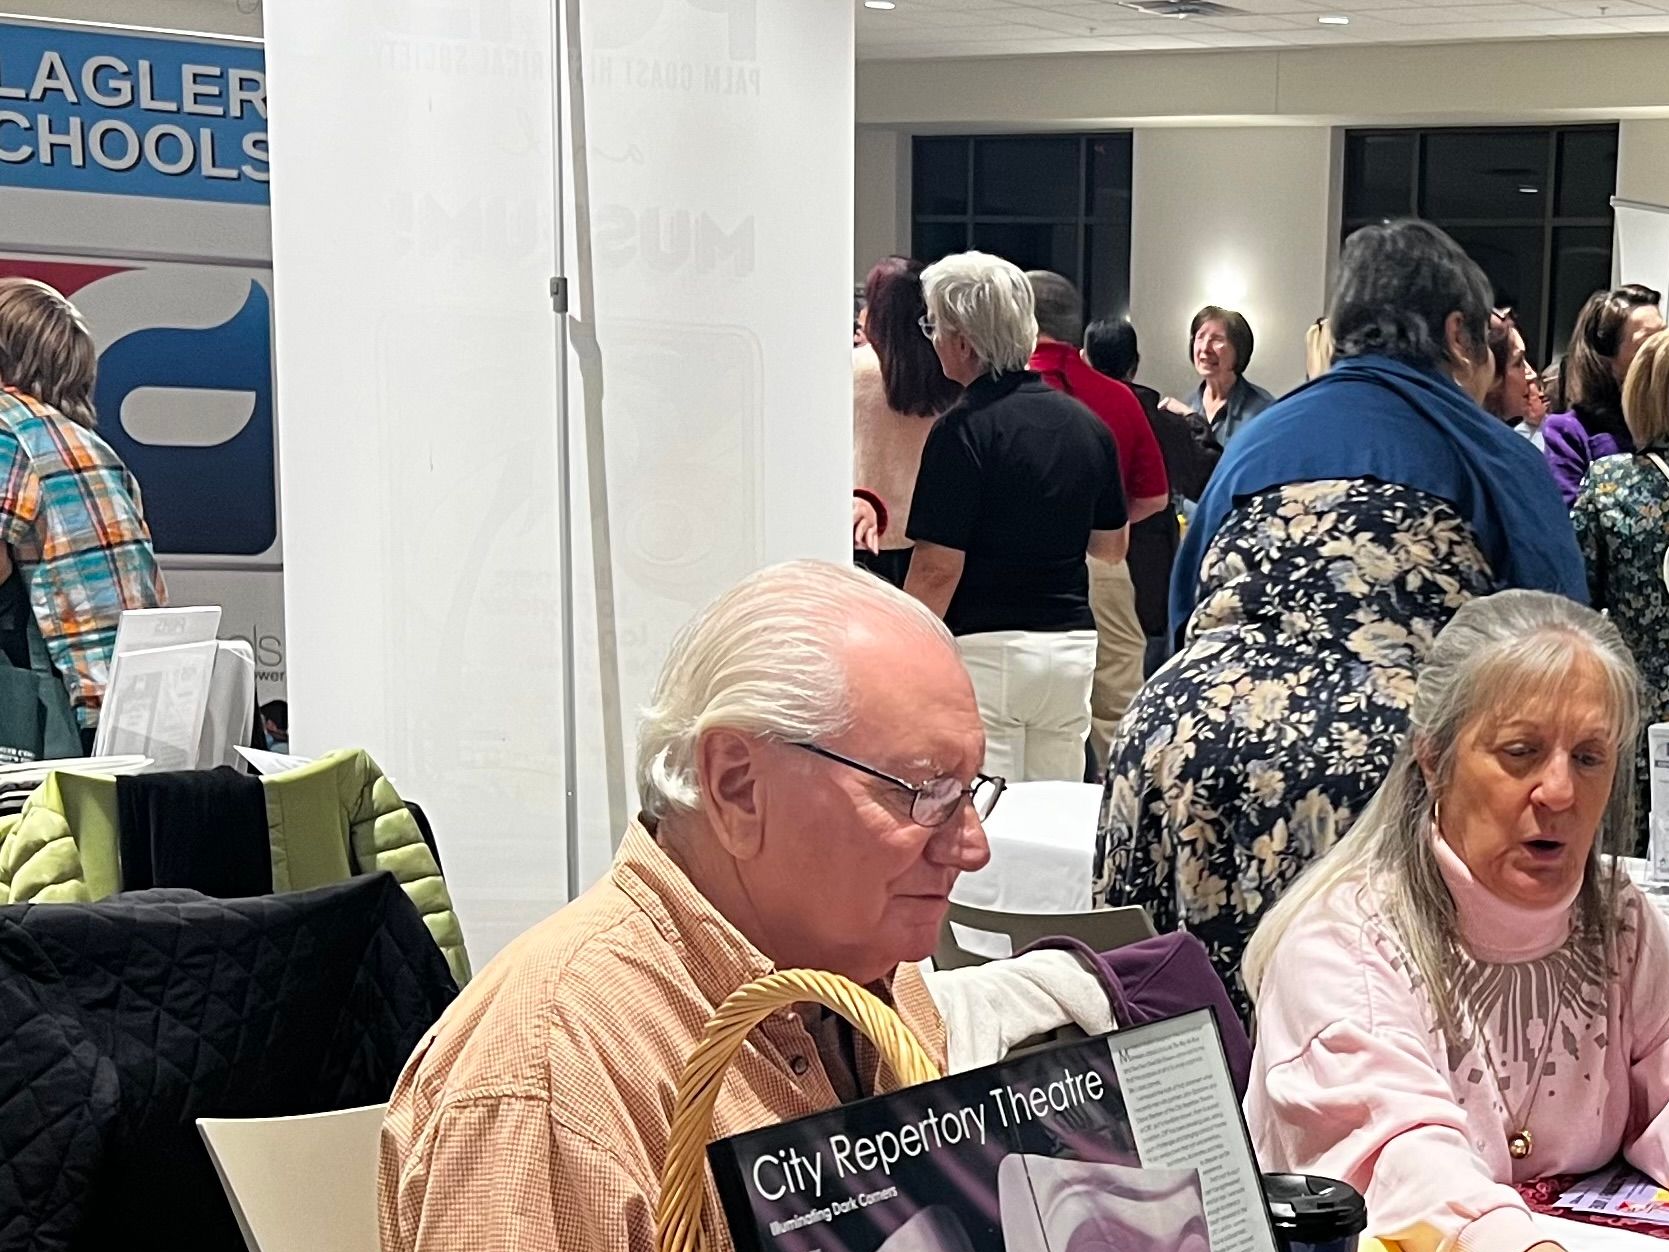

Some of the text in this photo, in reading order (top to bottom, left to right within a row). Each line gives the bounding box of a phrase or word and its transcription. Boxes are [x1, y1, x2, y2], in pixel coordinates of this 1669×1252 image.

[752, 1068, 1104, 1201] City Repertory Theatre
[831, 1197, 860, 1216] Dark
